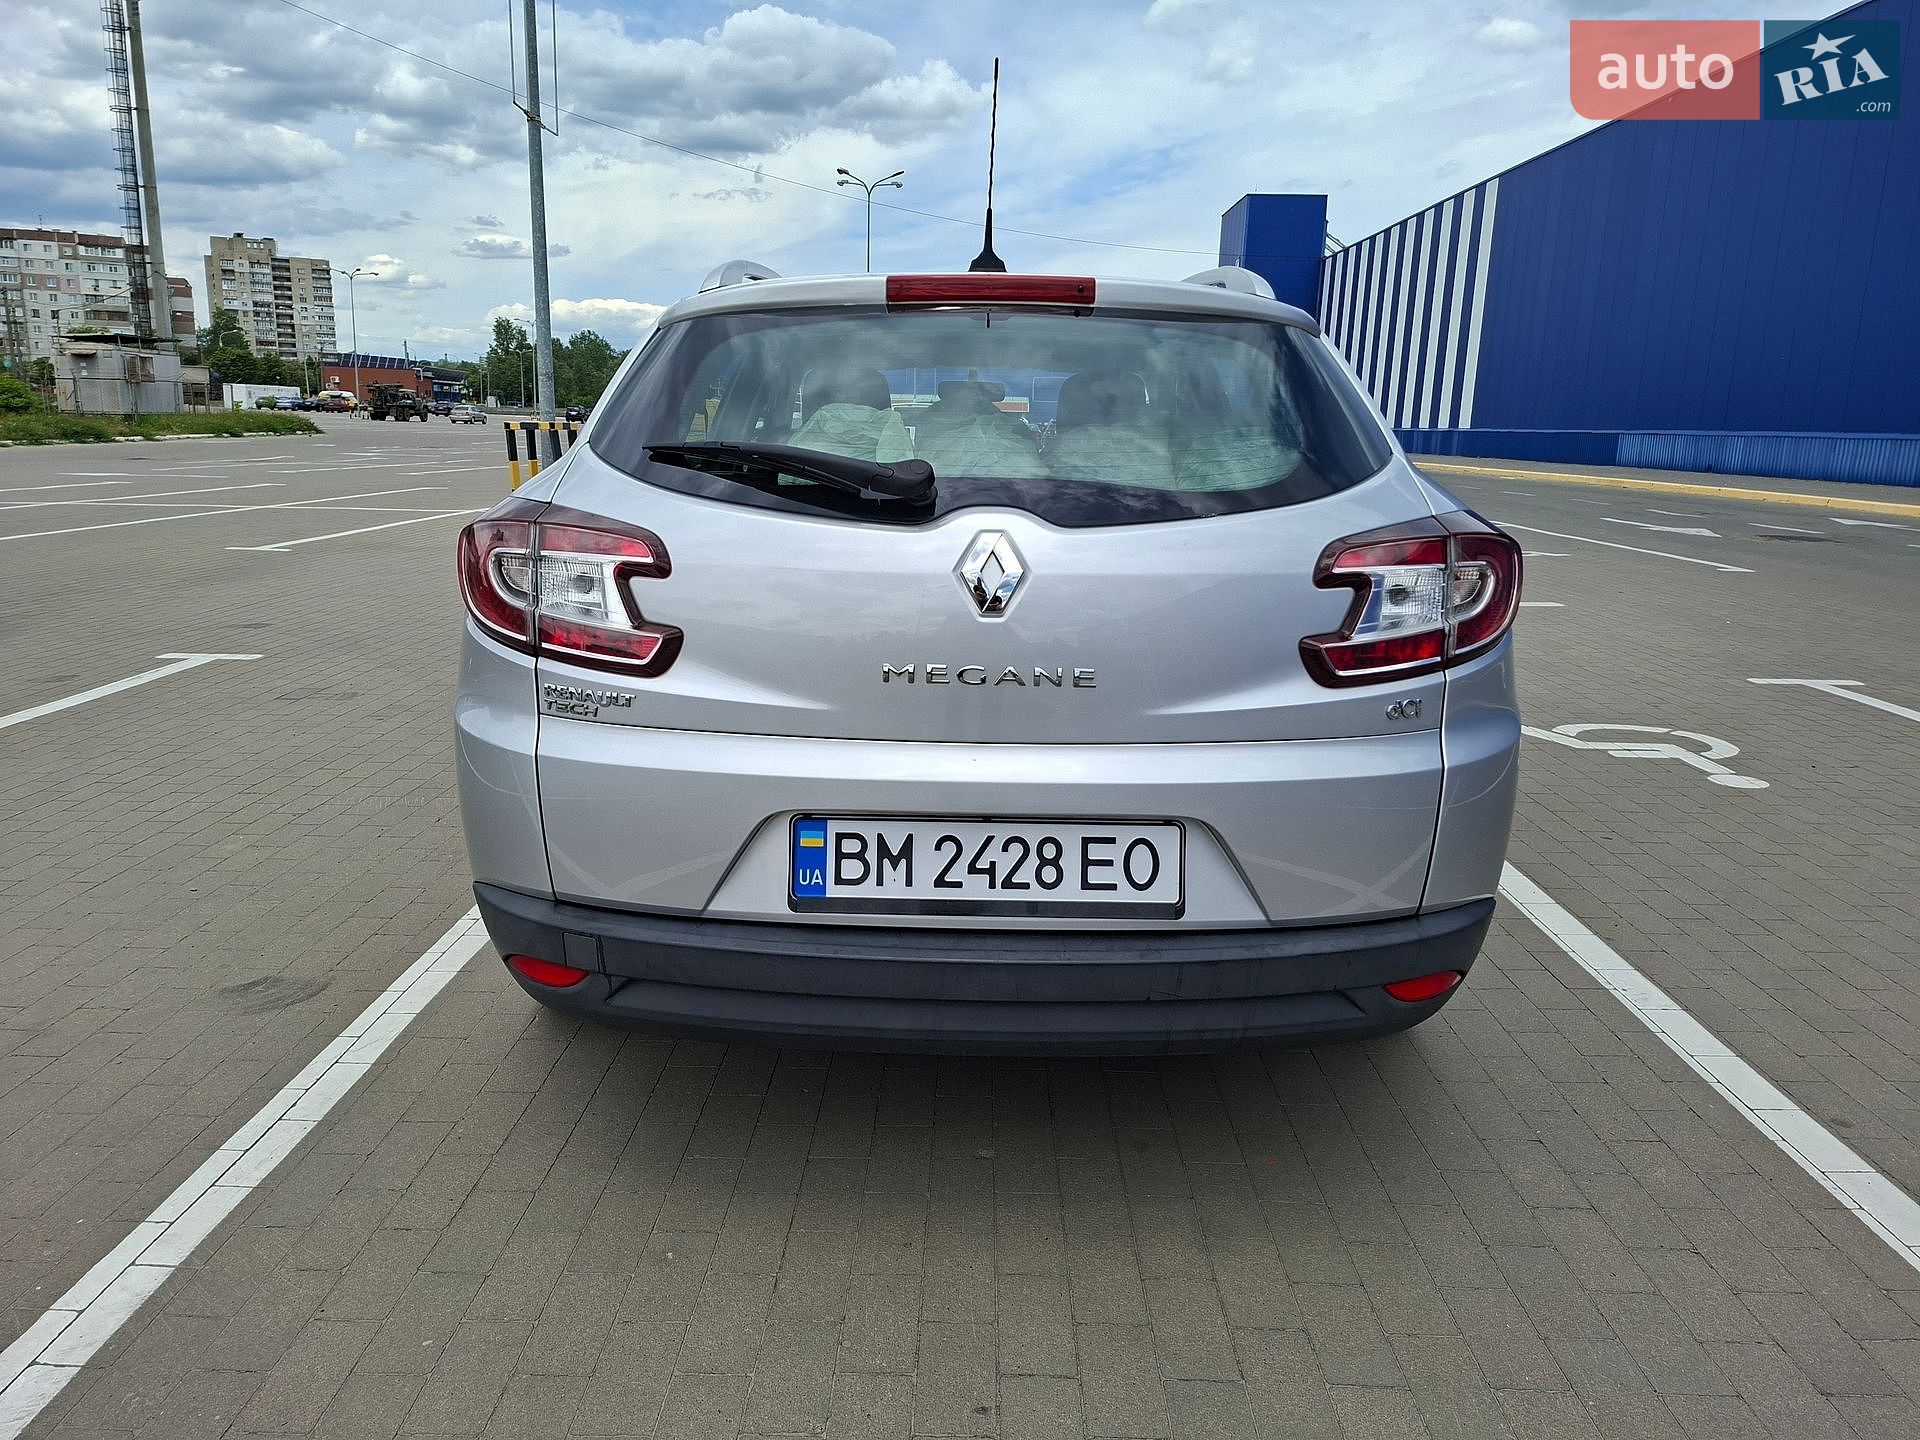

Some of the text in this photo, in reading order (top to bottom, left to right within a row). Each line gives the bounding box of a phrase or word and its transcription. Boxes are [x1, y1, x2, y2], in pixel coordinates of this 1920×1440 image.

[882, 663, 1097, 688] MEGANE
[543, 683, 636, 707] RENAULT
[544, 698, 599, 717] TECH
[833, 832, 1160, 892] BM 2428 EO
[799, 869, 823, 885] UA
